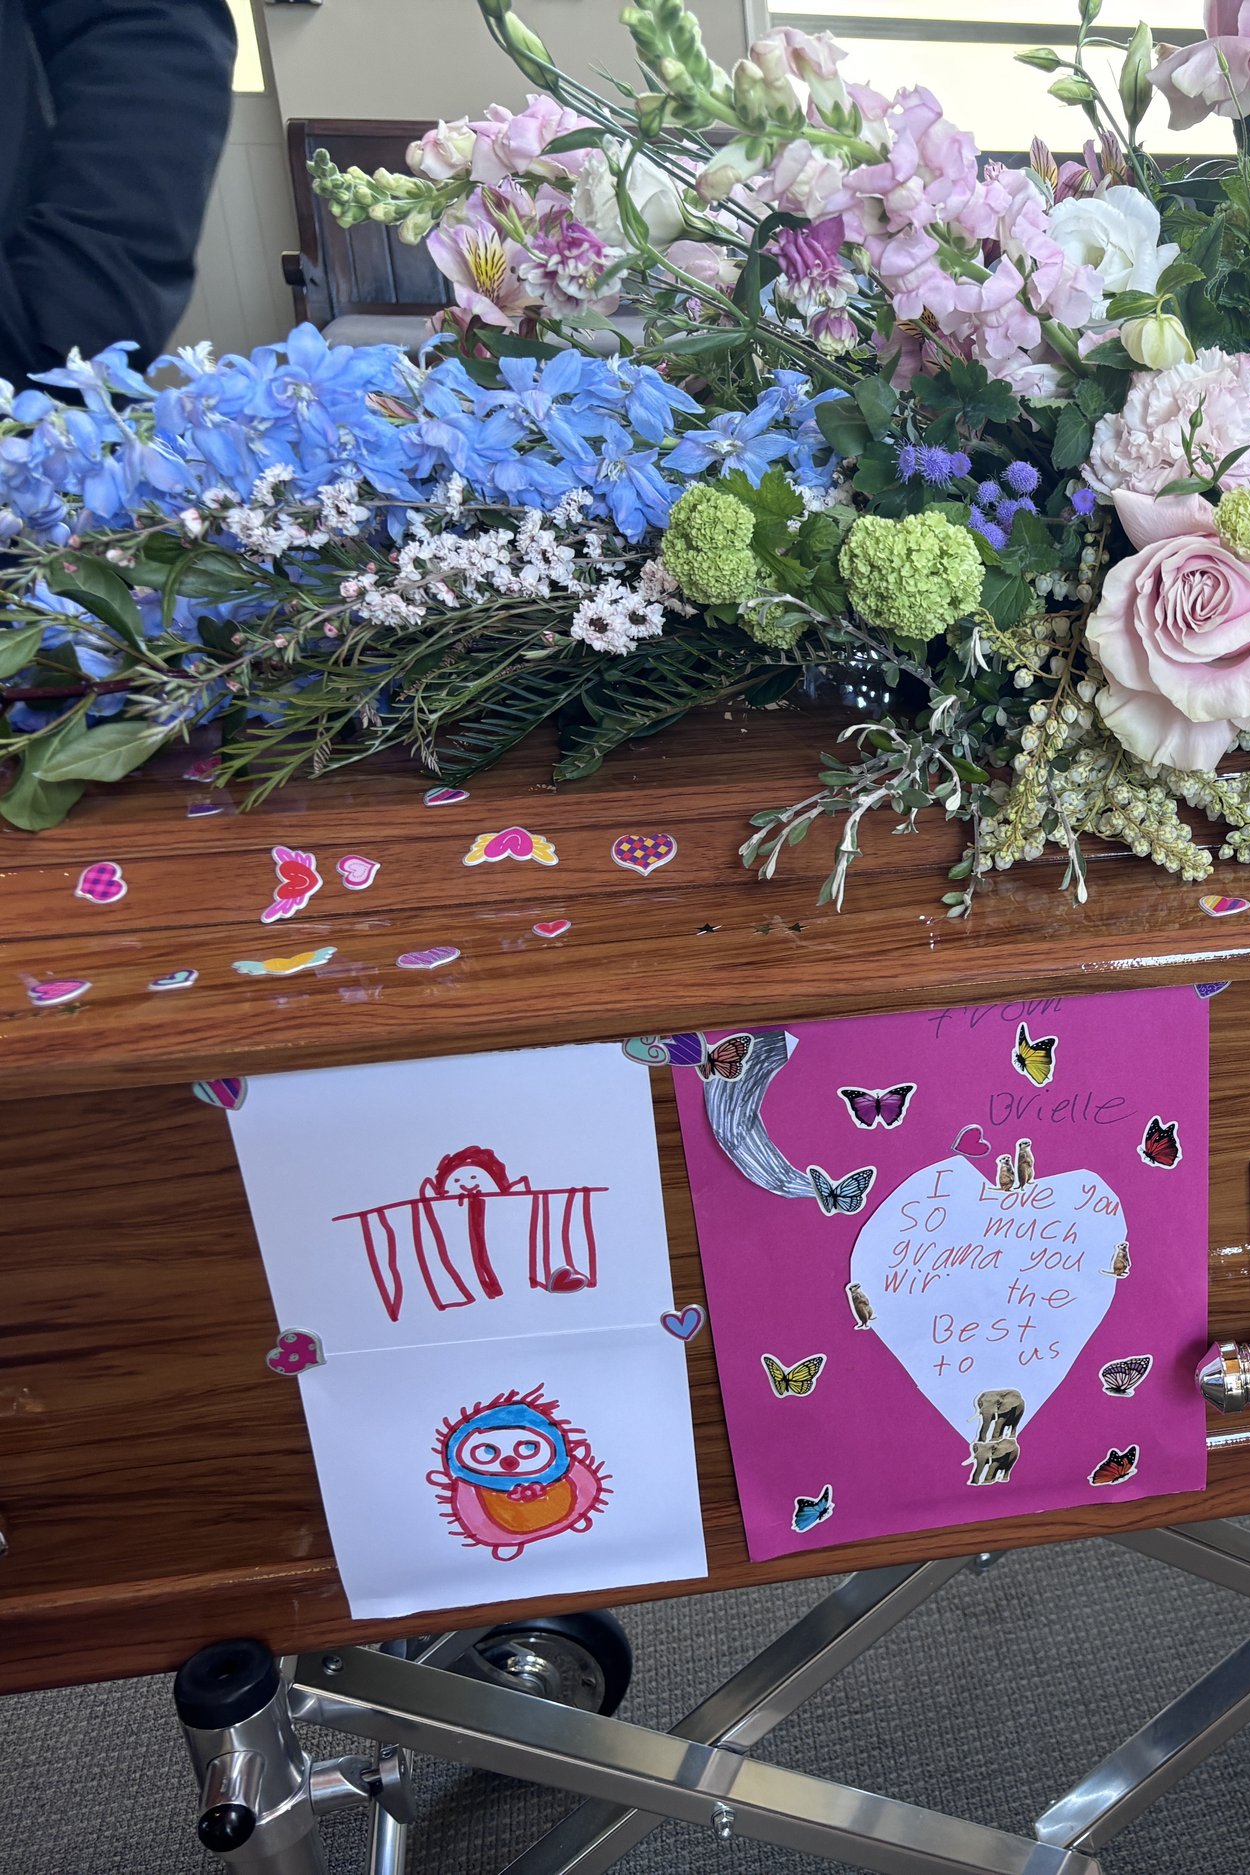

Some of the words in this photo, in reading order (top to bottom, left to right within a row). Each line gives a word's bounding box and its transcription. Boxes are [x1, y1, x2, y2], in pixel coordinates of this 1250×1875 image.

[989, 1089, 1138, 1126] Brielle
[926, 1169, 954, 1199] I
[983, 1216, 1078, 1245] much
[887, 1239, 1004, 1271] grama
[1019, 1247, 1085, 1273] you
[1007, 1277, 1078, 1309] the
[931, 1313, 1038, 1345] Best
[933, 1354, 975, 1377] to
[1018, 1340, 1061, 1366] us
